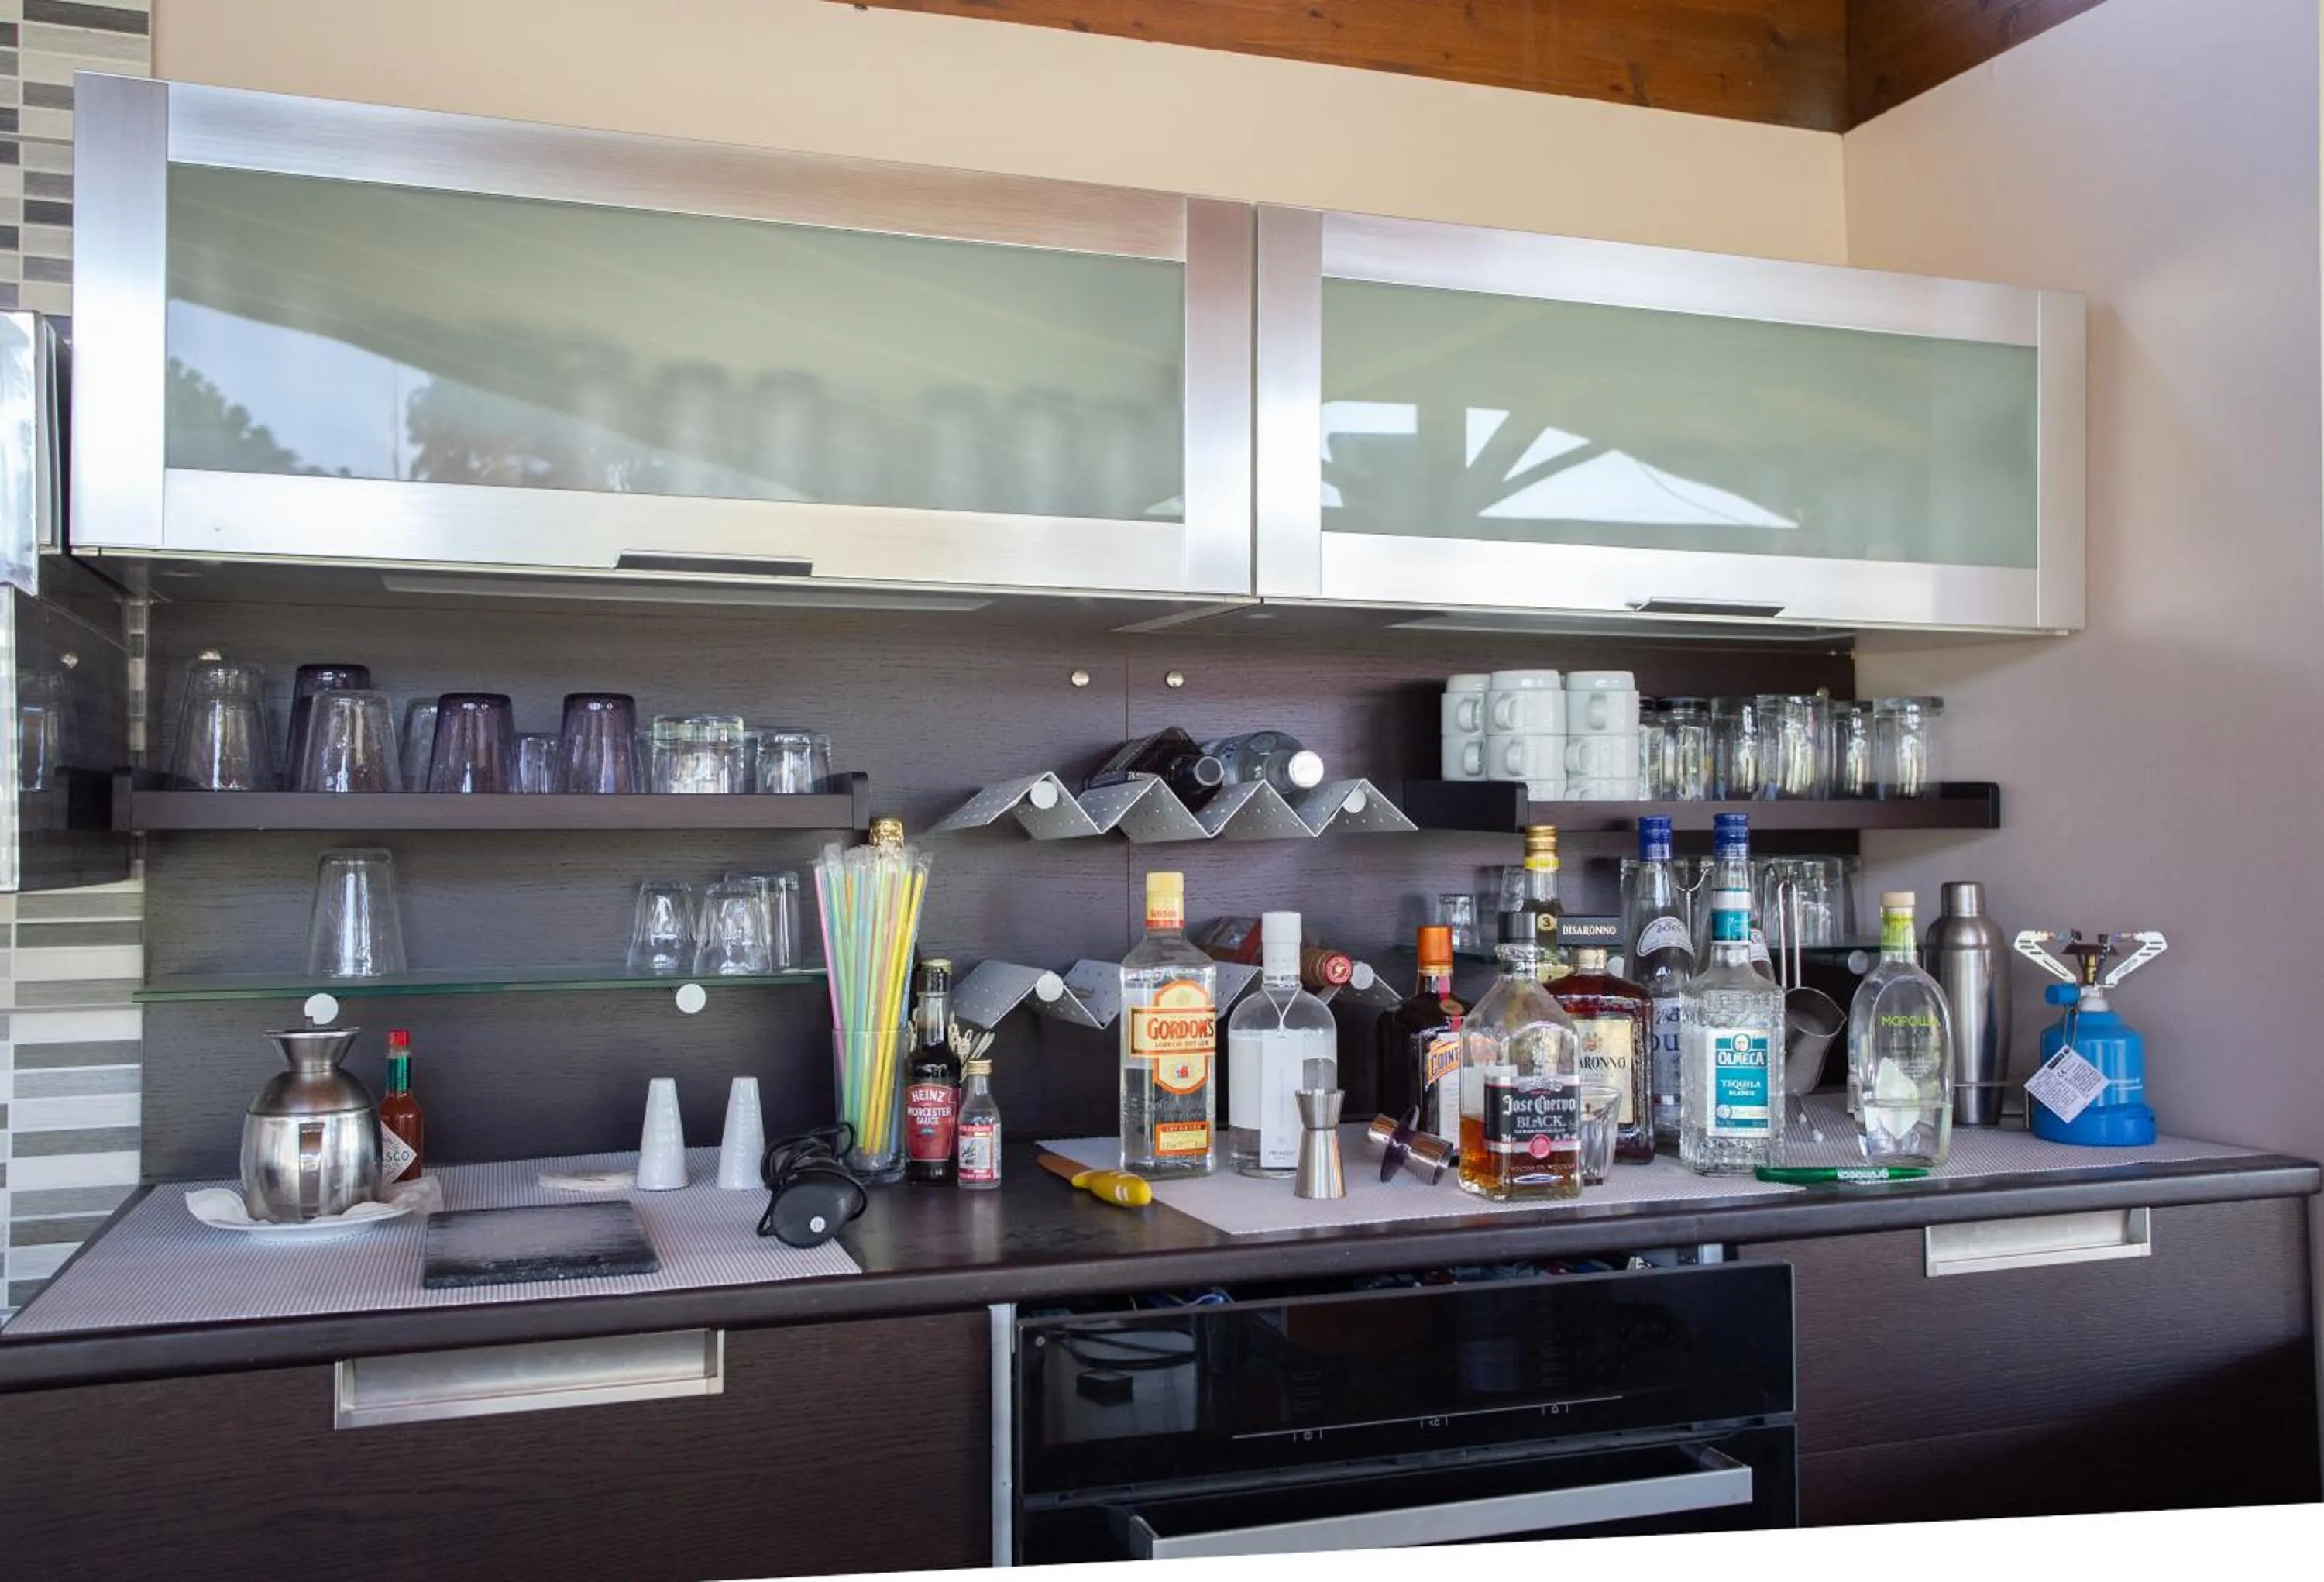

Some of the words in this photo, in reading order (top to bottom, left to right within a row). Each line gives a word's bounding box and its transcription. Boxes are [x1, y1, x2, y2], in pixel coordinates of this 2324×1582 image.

[1562, 925, 1617, 936] DISARONNO
[1147, 1018, 1214, 1040] GORDON'S
[1718, 1051, 1765, 1065] OLMECA
[1721, 1079, 1761, 1090] TEQUILA
[911, 1089, 947, 1102] HEINZ
[907, 1106, 951, 1116] WORCESTER
[1502, 1095, 1533, 1116] Jose
[1535, 1095, 1576, 1115] Cuervo
[916, 1116, 940, 1126] SAUCE
[1517, 1116, 1563, 1128] BLACK
